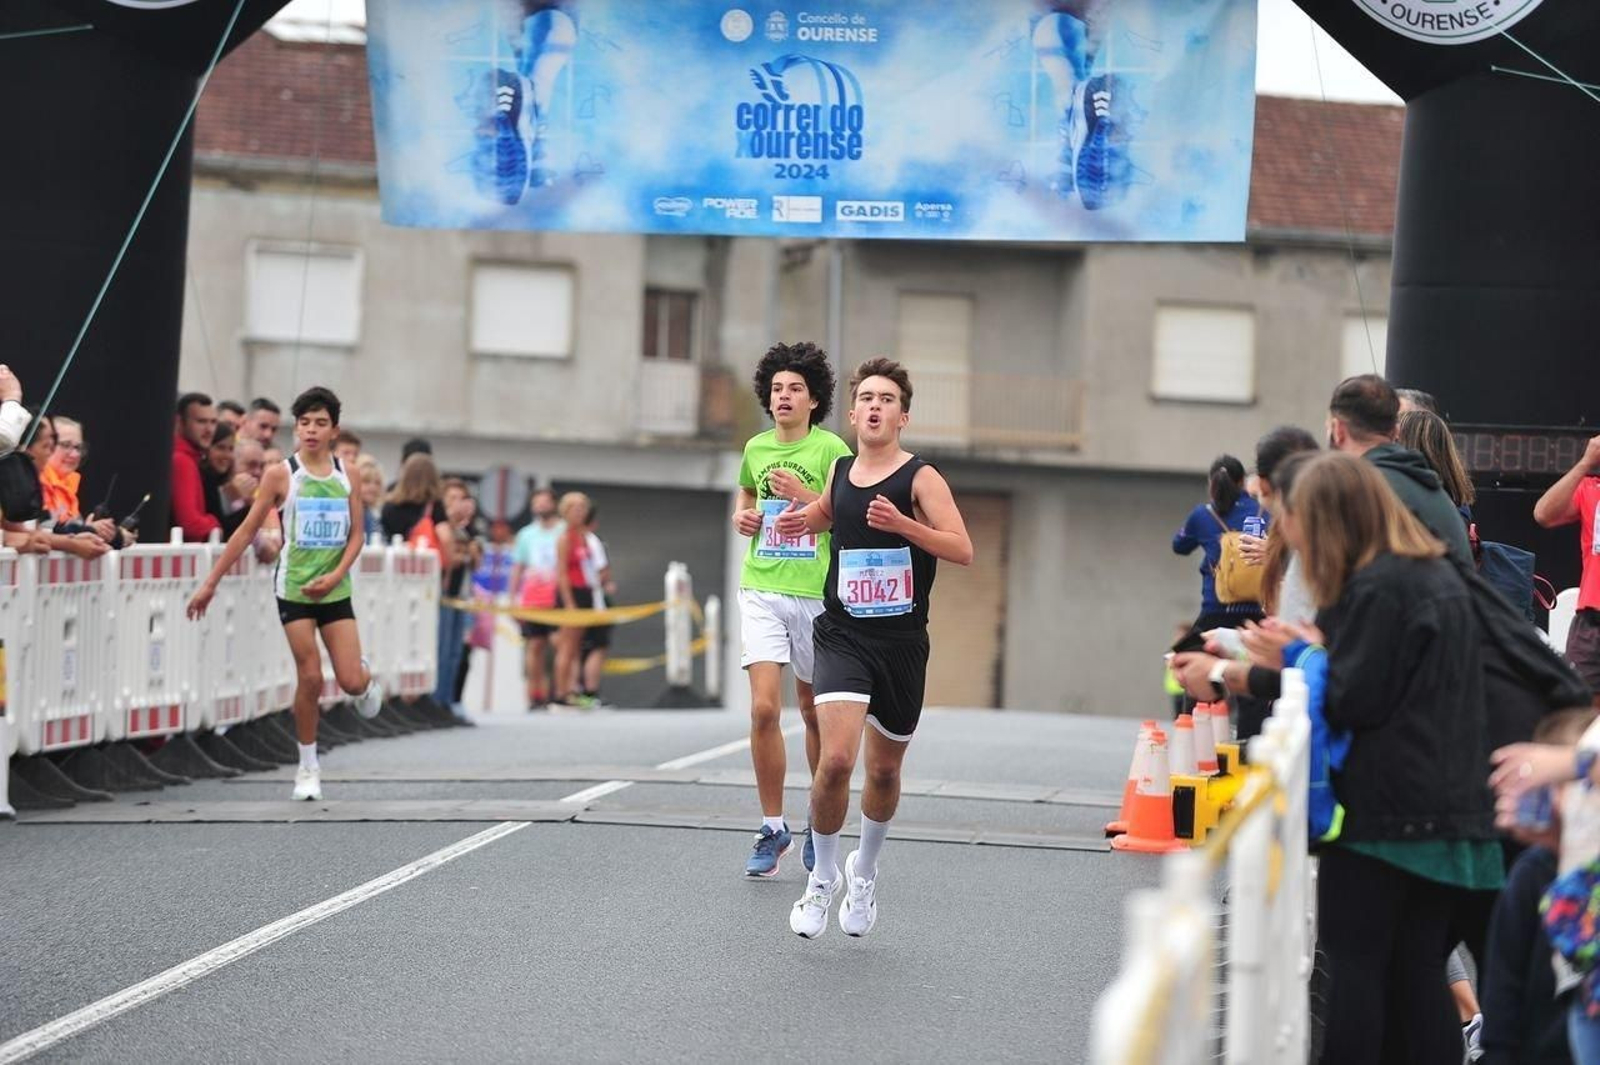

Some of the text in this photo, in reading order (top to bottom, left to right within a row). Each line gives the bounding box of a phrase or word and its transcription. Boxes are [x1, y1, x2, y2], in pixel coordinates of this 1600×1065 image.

[797, 11, 866, 25] Concello de
[1390, 2, 1494, 31] OURENSE
[797, 26, 878, 43] OURENSE
[736, 102, 864, 132] correr do
[774, 163, 830, 180] 2024
[840, 205, 900, 218] GADIS
[783, 461, 815, 485] OURENSE
[303, 520, 341, 539] 4007
[847, 578, 899, 604] 3042
